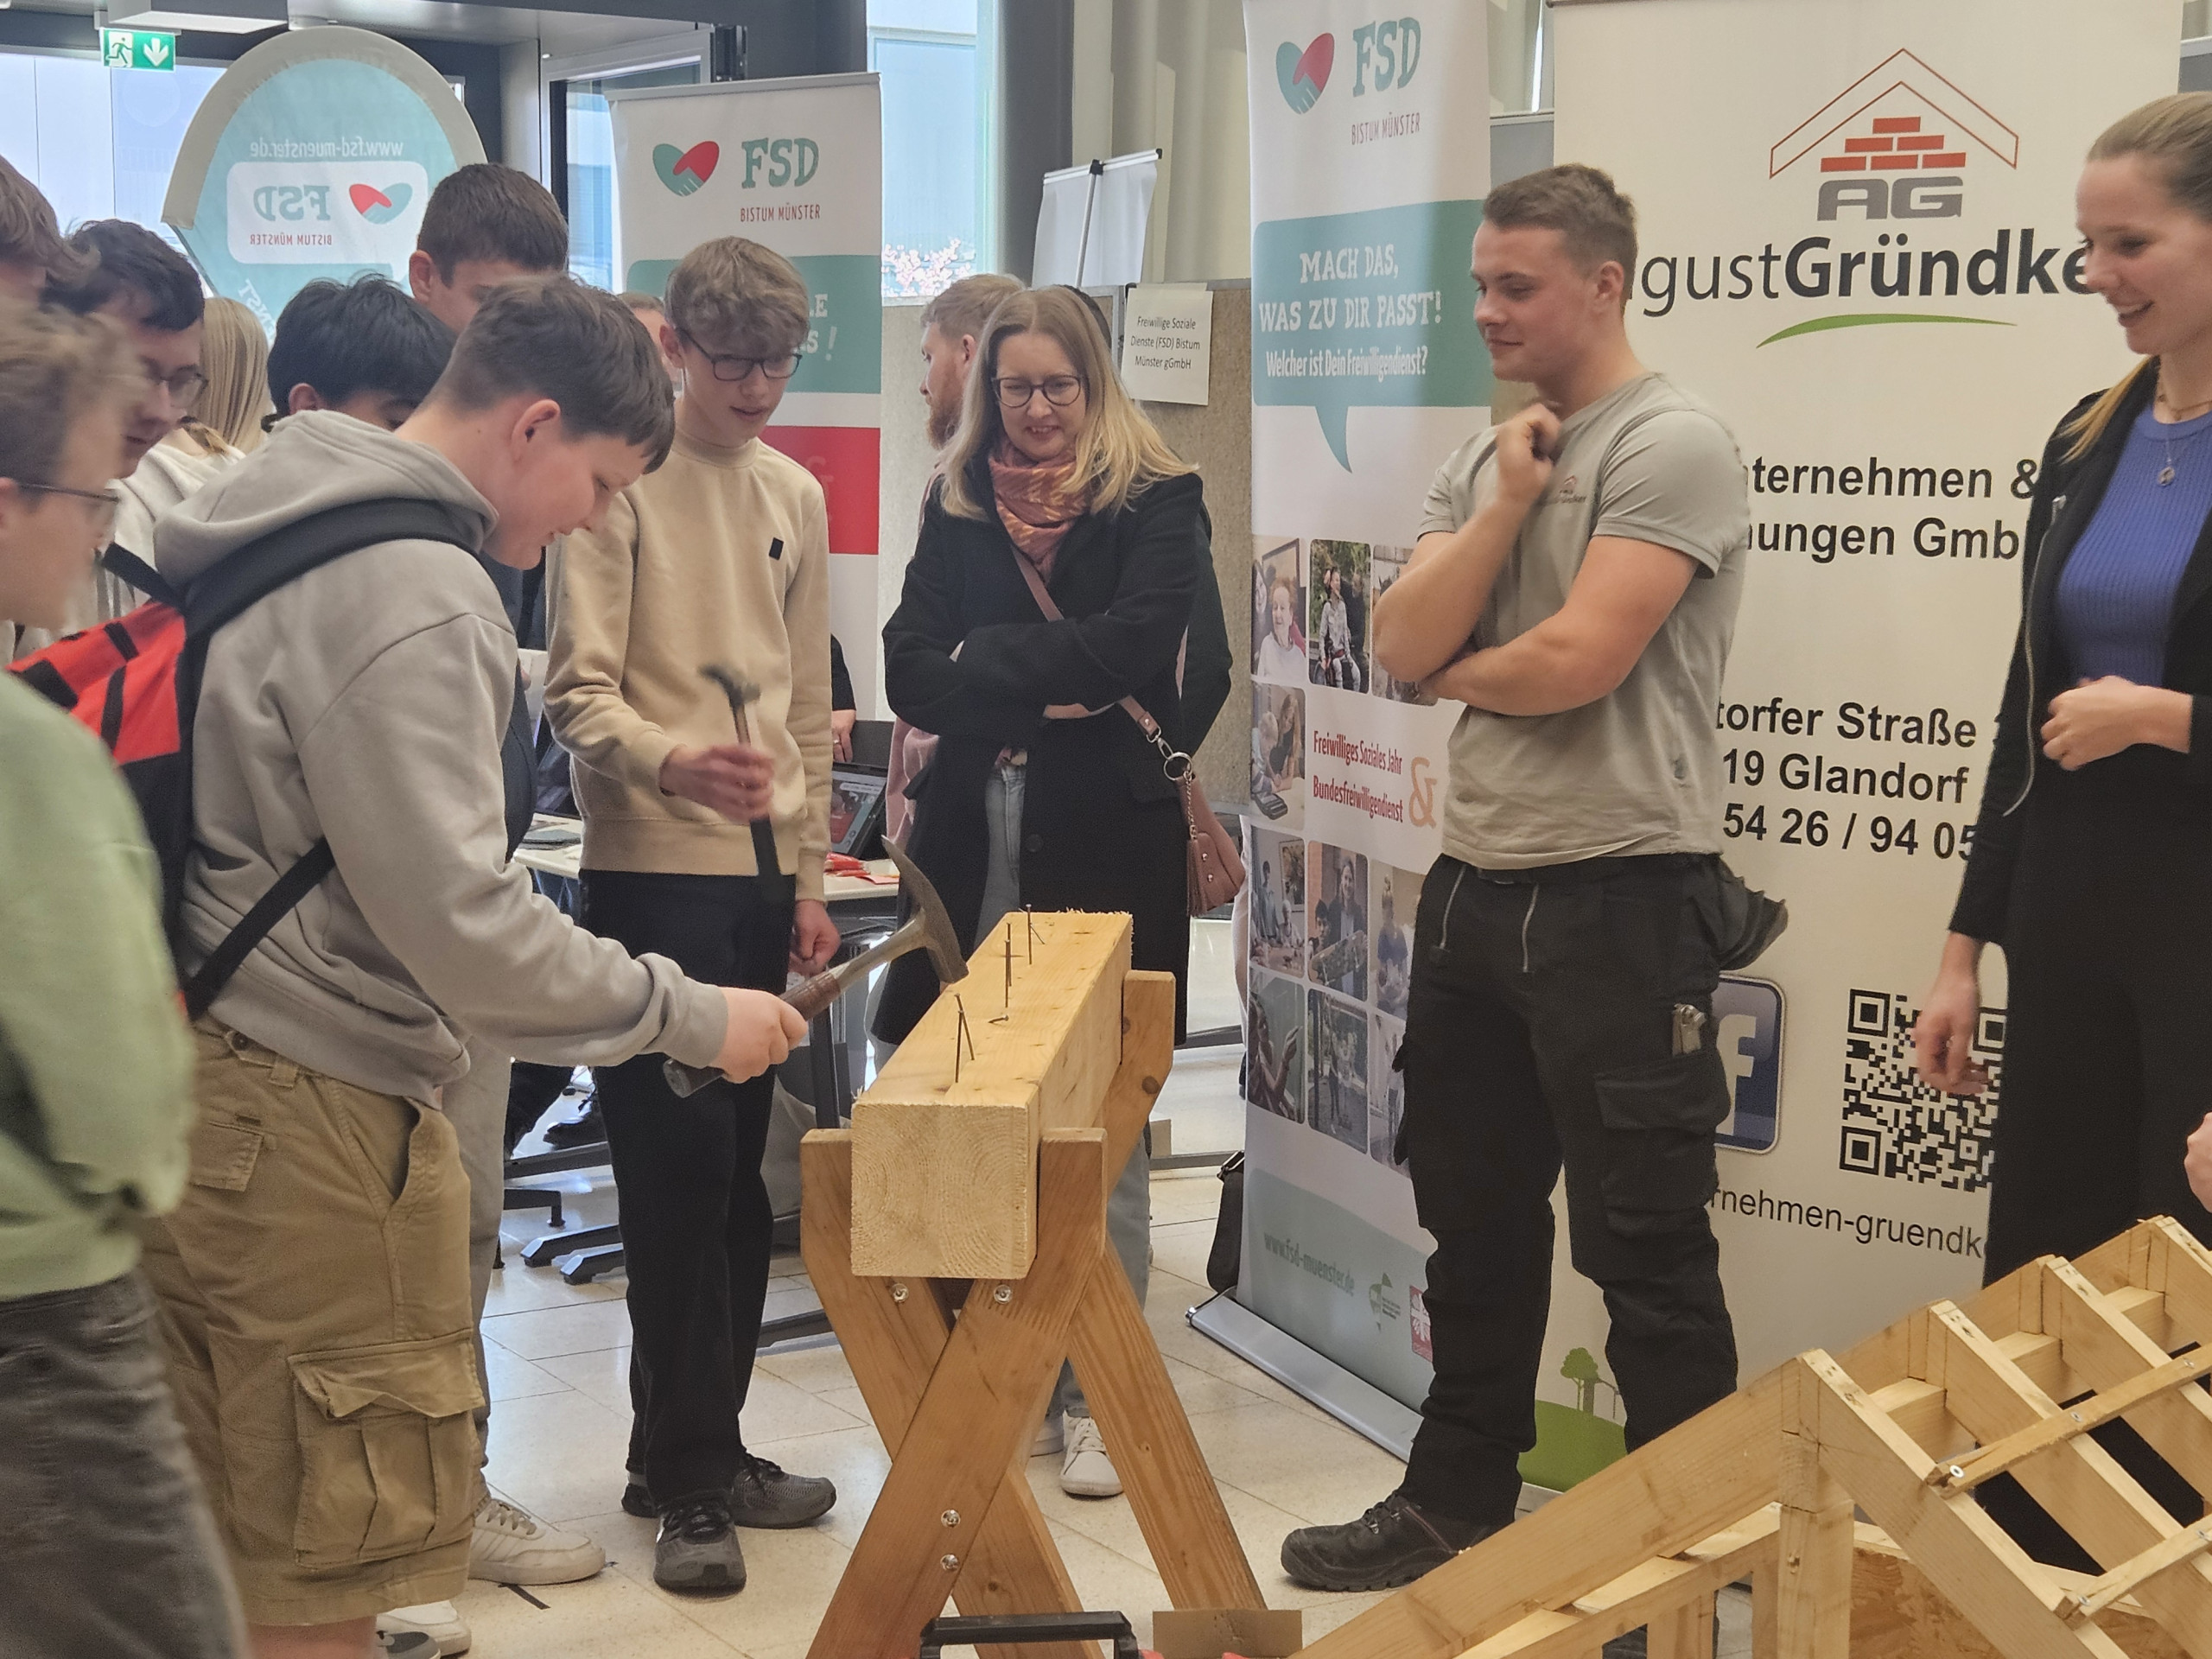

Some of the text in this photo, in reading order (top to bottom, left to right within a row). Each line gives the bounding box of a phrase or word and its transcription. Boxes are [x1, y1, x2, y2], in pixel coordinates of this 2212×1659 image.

[1352, 16, 1421, 98] FSD
[1351, 111, 1421, 145] BISTUM MÜNSTER
[741, 137, 819, 189] FSD
[740, 201, 821, 222] BISTUM MÜNSTER
[1816, 175, 1964, 221] AG
[1300, 243, 1399, 284] MACH DAS,
[1630, 228, 2095, 317] gustGründke
[1137, 315, 1196, 331] Freiwillige Soziale
[1258, 290, 1442, 333] WAS ZU DIR PASST!
[1130, 335, 1200, 350] Dienste (FSD) Bistum
[1135, 355, 1192, 371] Münster gGmbH
[1266, 349, 1307, 378] Welcher
[1309, 348, 1324, 377] ist
[1325, 348, 1346, 377] Dein
[1744, 456, 1993, 499] ternehmen
[1837, 702, 1977, 748] Straße
[1313, 730, 1403, 775] Freiwilliges Soziales Jahr
[1313, 775, 1403, 823] Bundesfreiwilligendienst
[1779, 753, 1970, 804] Glandorf
[1723, 803, 1767, 841] 54
[1780, 808, 1828, 847] 26
[1841, 812, 1857, 850] /
[1870, 816, 1918, 855] 94
